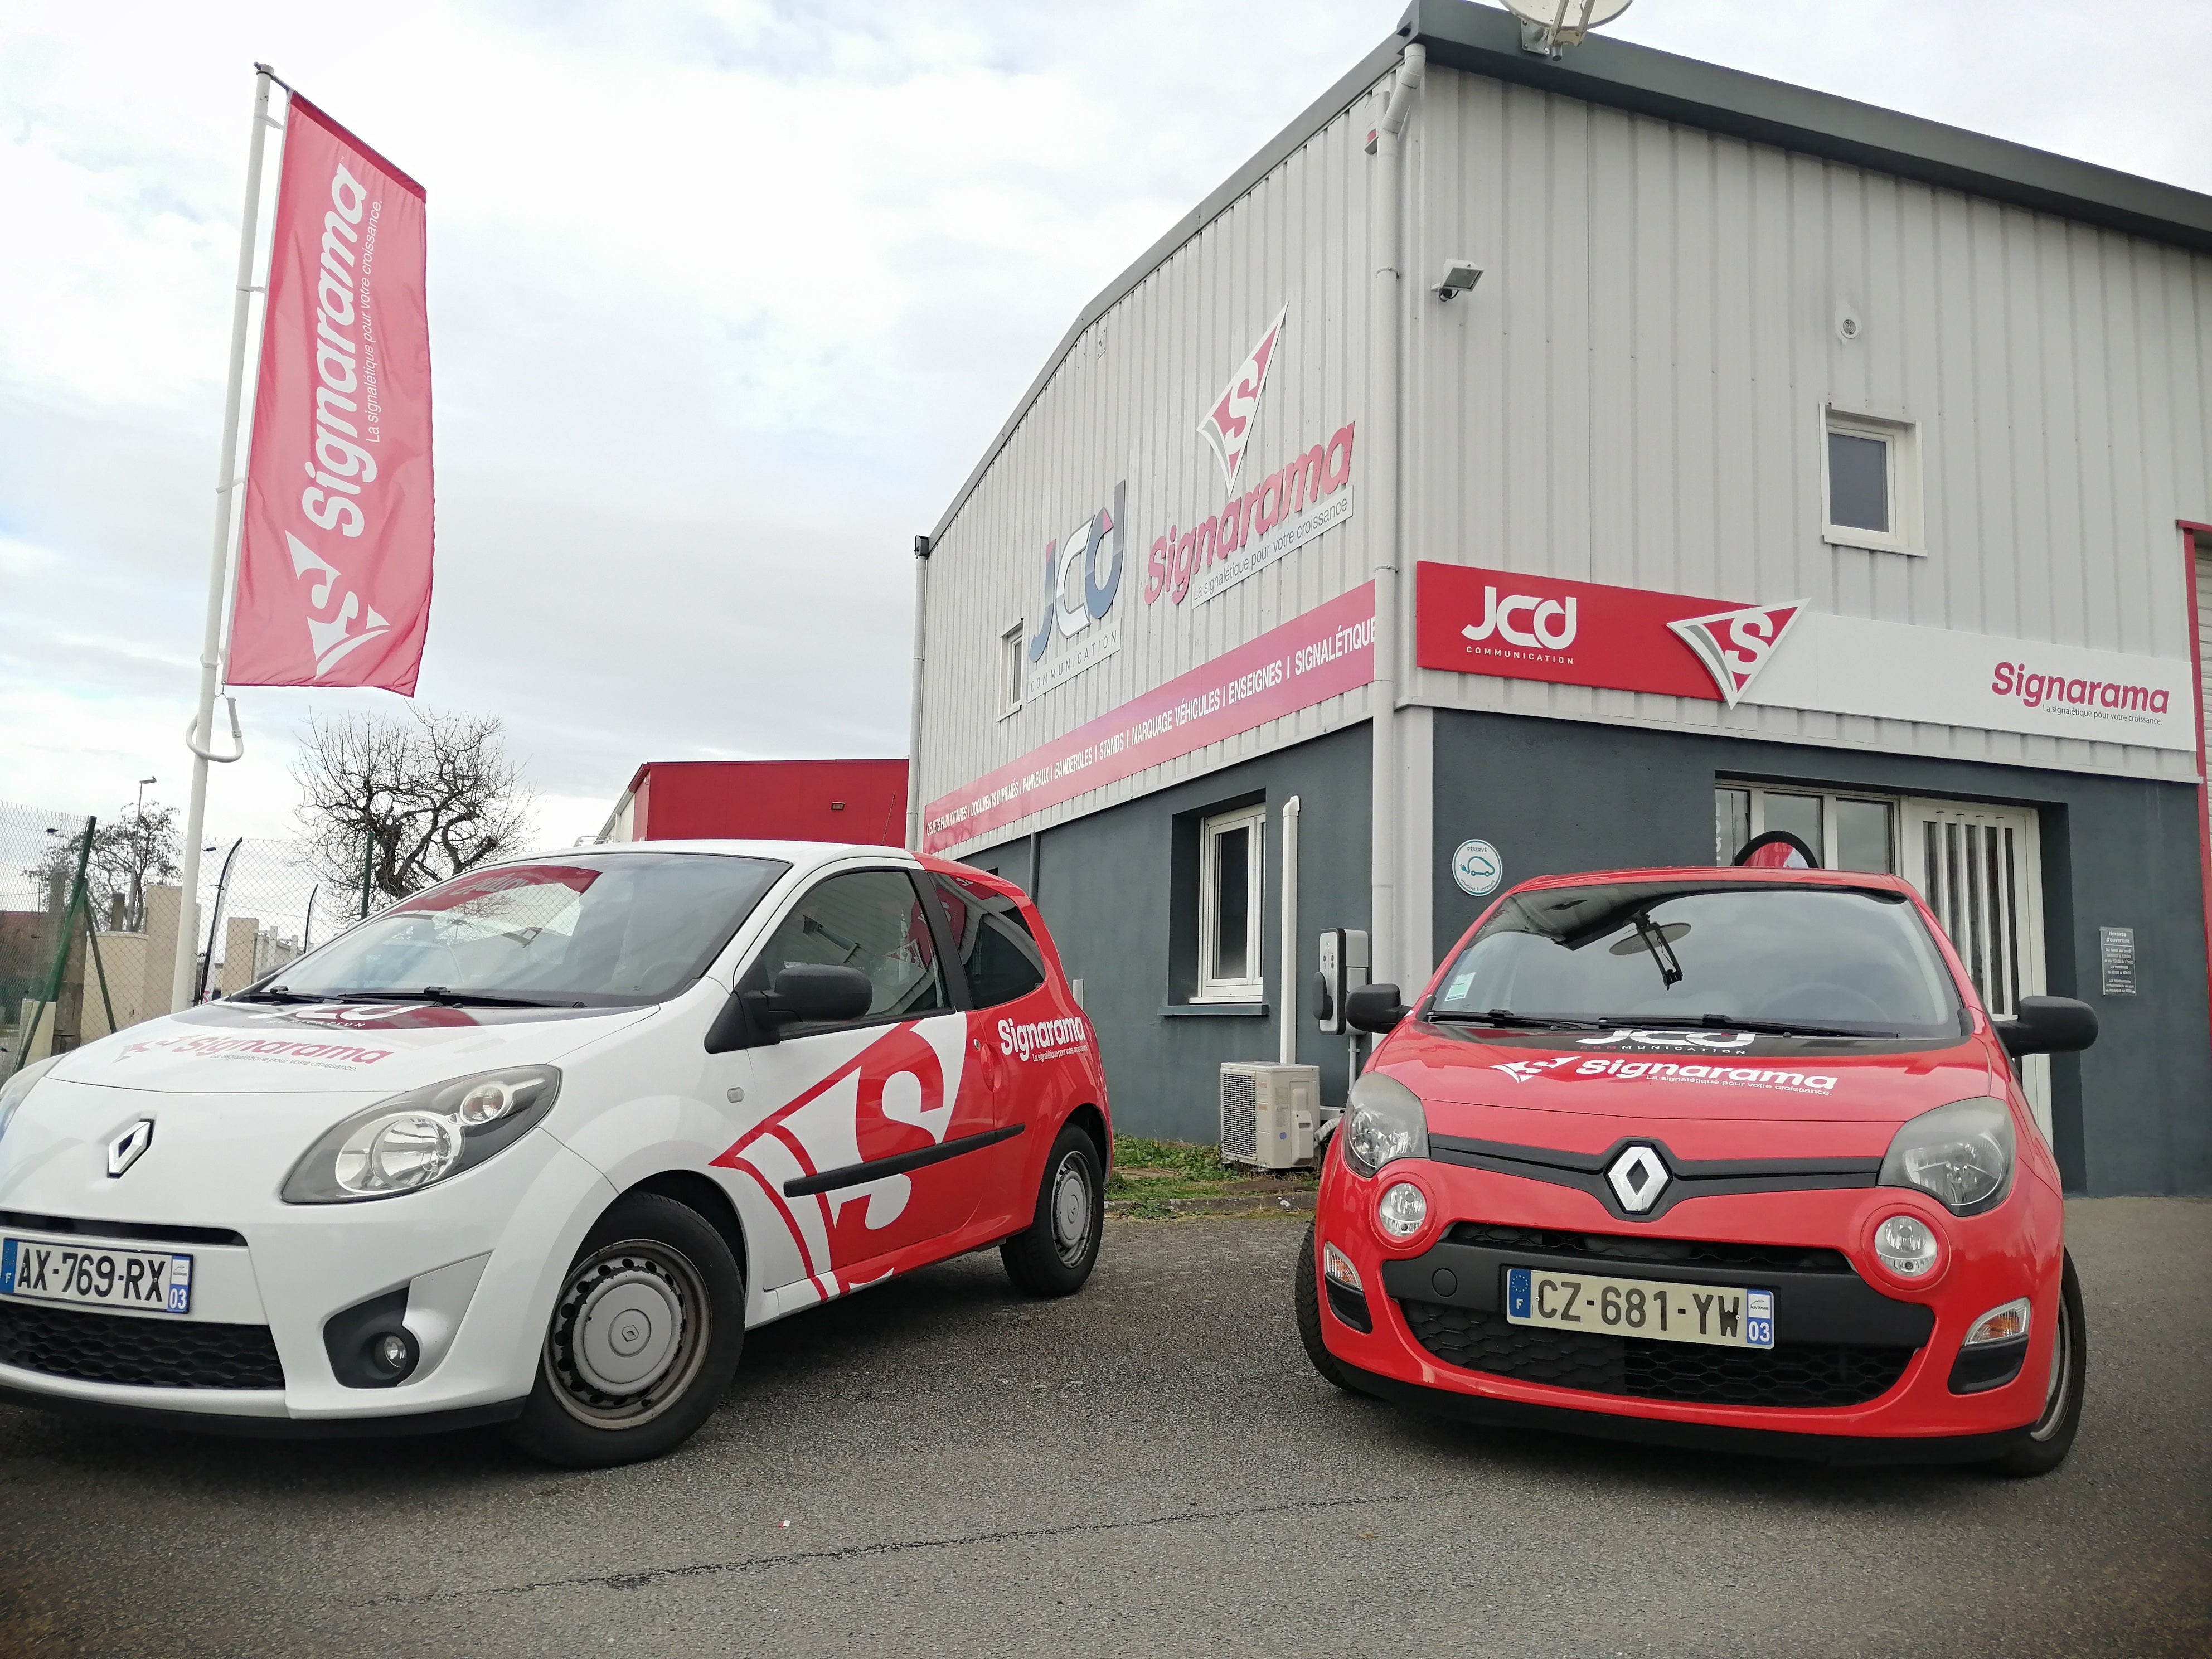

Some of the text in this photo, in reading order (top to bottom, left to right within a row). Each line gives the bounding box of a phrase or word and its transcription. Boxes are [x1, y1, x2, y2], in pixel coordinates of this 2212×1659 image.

[361, 201, 383, 443] La signalétique pour votre croissance.
[302, 162, 377, 537] Signarama
[1144, 421, 1355, 605] Signarama
[1194, 498, 1347, 600] La signalétique pour votre croissance
[1031, 630, 1117, 692] COMMUNICATION
[1466, 646, 1574, 664] COMMUNICATION
[1229, 660, 1282, 705] ENSEIGNES
[1992, 662, 2170, 714] Signarama
[1132, 688, 1220, 746] MARQUAGE VÉHICULES
[2043, 704, 2163, 725] La signalétique pour votre croissance.
[1099, 732, 1124, 760] STANDS
[1055, 747, 1093, 779] BANDEROLES
[1023, 766, 1049, 792] PANNEAUX
[971, 778, 1018, 817] DOCUMENTS IMPRIMÉS
[926, 805, 967, 836] OBJETS PUBLICITAIRES
[171, 1035, 395, 1064] Signarama
[998, 1017, 1086, 1061] Signarama
[1580, 1045, 1745, 1055] COMMUNICATION
[1575, 1059, 1839, 1090] Signarama
[1661, 1075, 1719, 1084] signalétique
[1775, 1085, 1832, 1095] croissance.
[6, 1273, 11, 1283] F
[17, 1248, 166, 1302] AX-769-RX
[170, 1288, 186, 1309] 03
[1516, 1298, 1523, 1309] F
[1537, 1279, 1740, 1337] CZ-681-YW
[1749, 1321, 1770, 1342] 03
